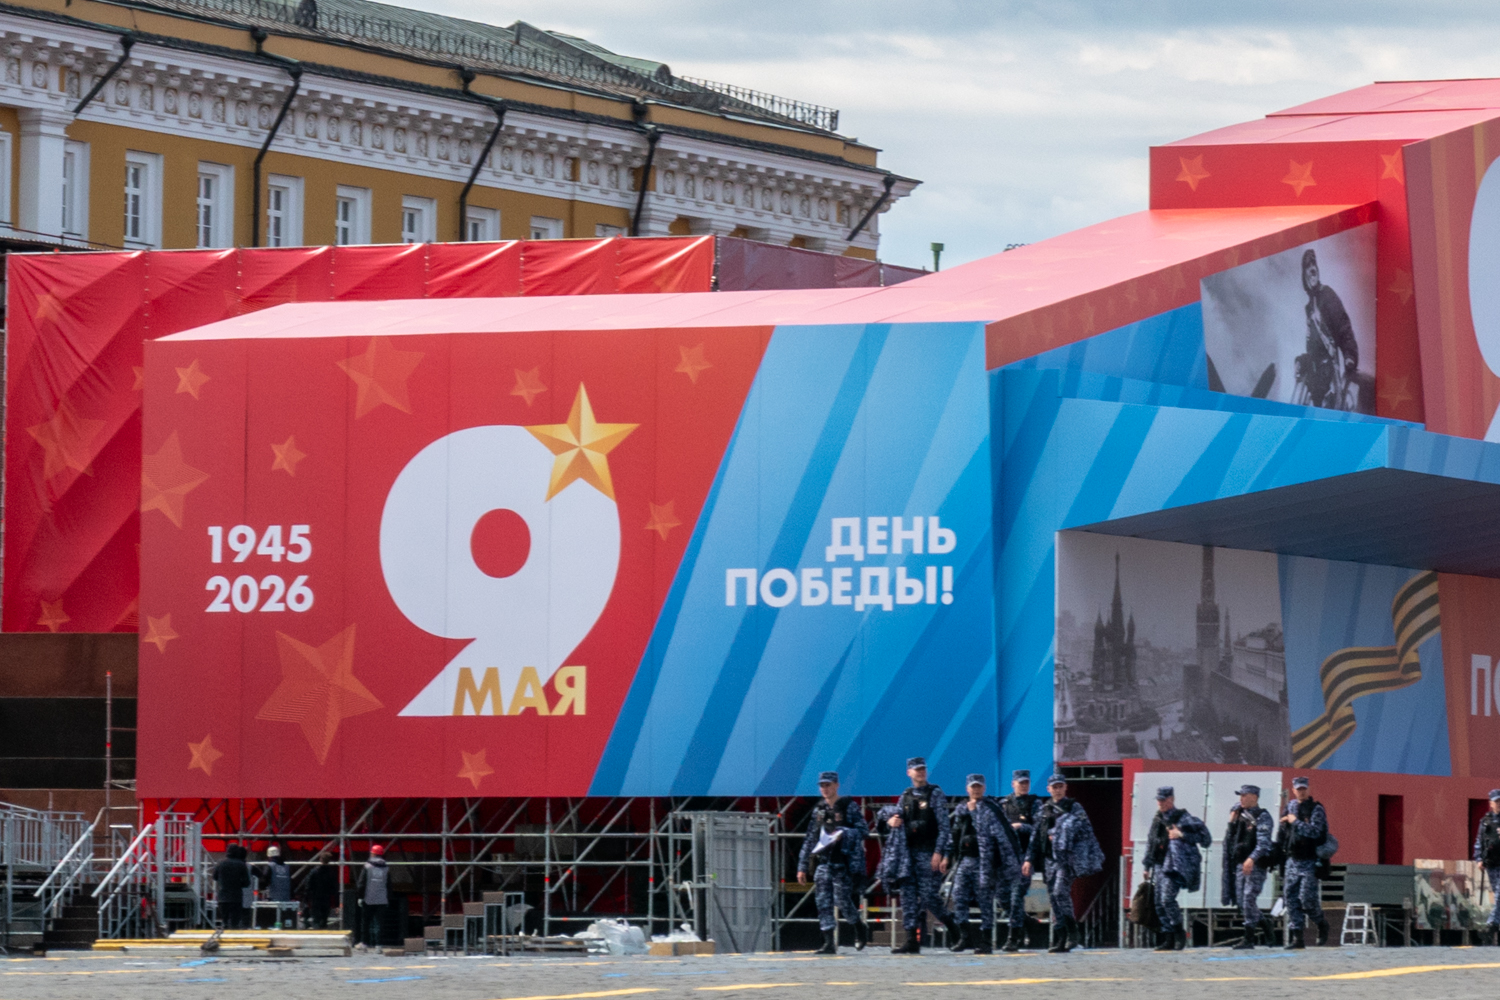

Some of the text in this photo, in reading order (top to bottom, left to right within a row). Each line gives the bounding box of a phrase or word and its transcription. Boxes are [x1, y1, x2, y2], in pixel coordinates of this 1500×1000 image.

[207, 524, 312, 563] 1945
[825, 516, 957, 562] ДЕНЬ
[204, 575, 314, 612] 2026
[379, 425, 621, 716] 9 МАЯ
[725, 565, 954, 611] ПОБЕДЫ!
